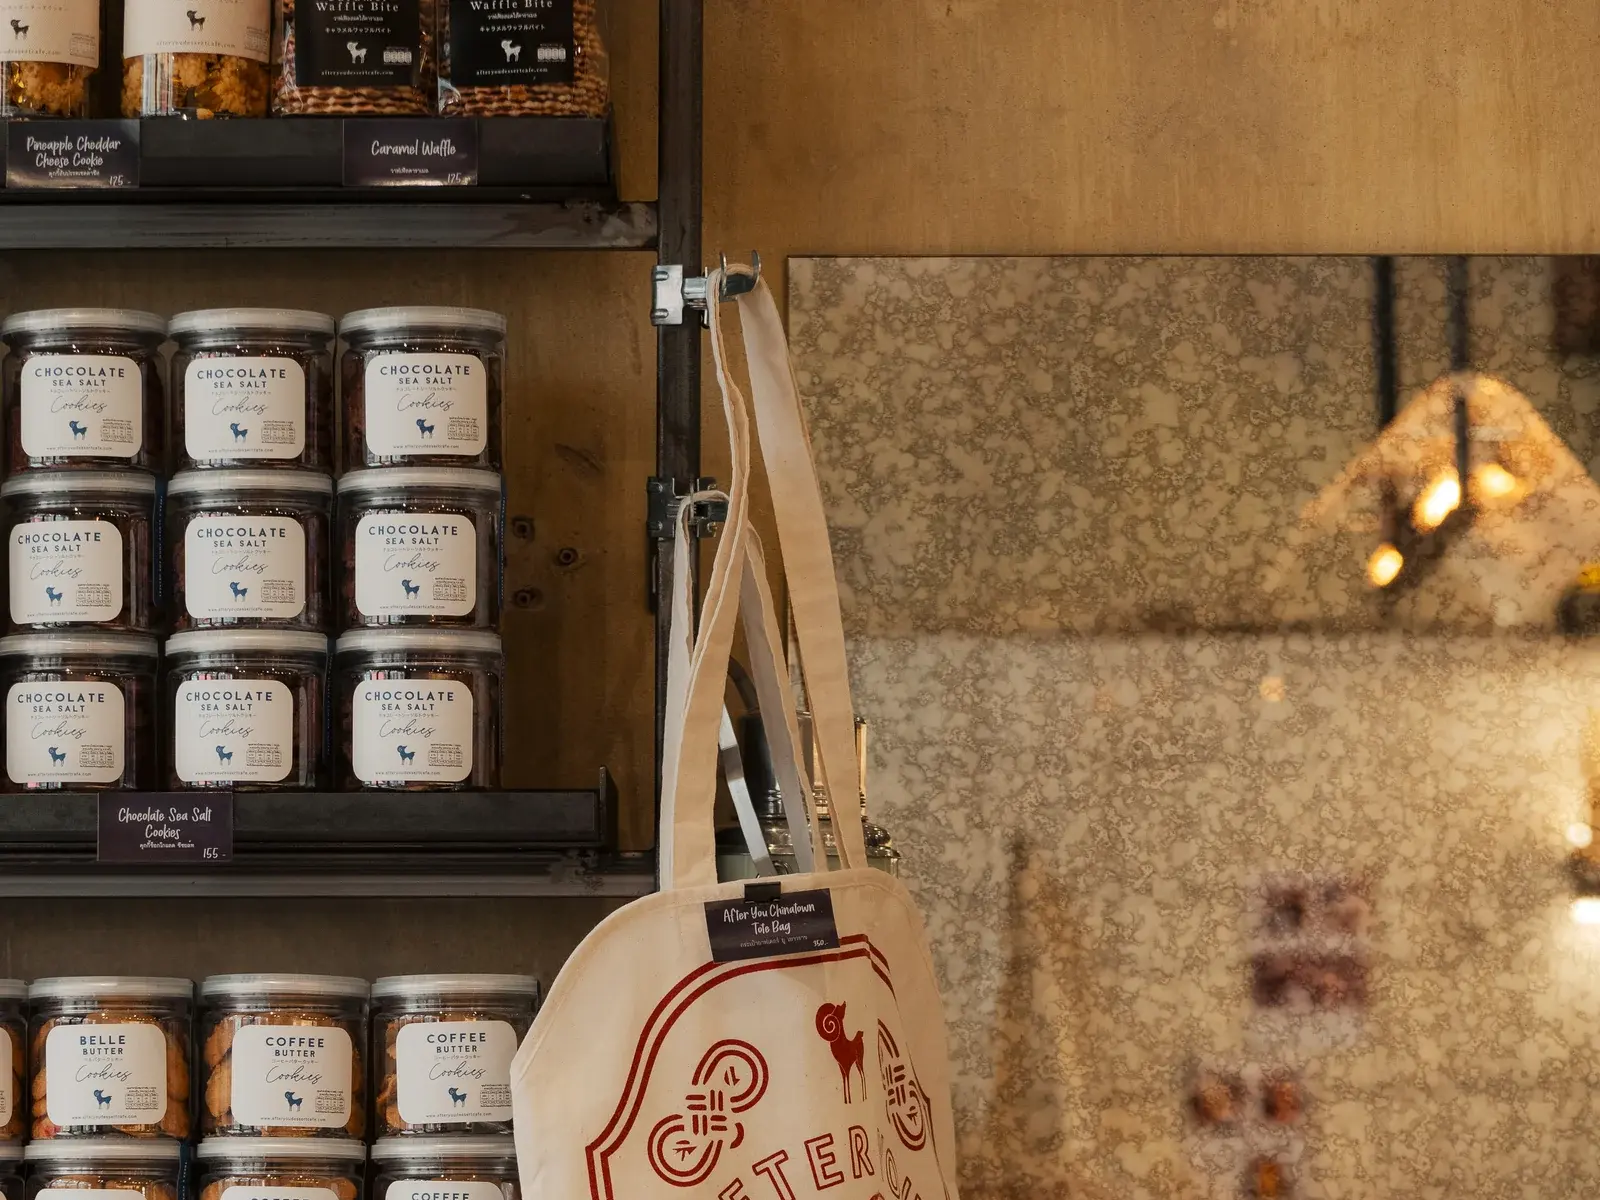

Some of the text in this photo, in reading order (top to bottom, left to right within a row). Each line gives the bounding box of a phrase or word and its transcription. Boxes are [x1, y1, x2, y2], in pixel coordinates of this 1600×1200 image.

[316, 2, 399, 12] Waffle Bite
[470, 0, 520, 11] Waffle
[26, 135, 121, 155] Pineapple Cheddar
[371, 139, 456, 157] Caramel Waffle
[35, 152, 103, 168] Cheese Cookie
[35, 366, 125, 378] CHOCOLATE
[197, 368, 287, 380] CHOCOLATE
[380, 364, 470, 376] CHOCOLATE
[52, 378, 106, 387] SEA SALT
[239, 381, 267, 389] SALT
[399, 377, 452, 385] SEA SALT
[51, 395, 108, 414] Cookies
[212, 397, 269, 416] Cookies
[397, 392, 455, 412] Cookies
[197, 527, 286, 538] CHOCOLATE
[368, 525, 458, 536] CHOCOLATE
[18, 532, 101, 544] CHOCOLATE
[412, 537, 439, 545] SALT
[54, 544, 81, 552] SALT
[212, 555, 269, 575] Cookies
[383, 553, 441, 573] Cookies
[30, 560, 83, 580] Cookies
[17, 693, 105, 703] CHOCOLATE
[186, 691, 273, 701] CHOCOLATE
[365, 691, 455, 702] CHOCOLATE
[33, 705, 85, 713] SEA SALT
[200, 703, 253, 711] SEA SALT
[381, 703, 435, 711] SEA SALT
[31, 720, 87, 740] Cookies
[199, 719, 255, 739] Cookies
[379, 719, 436, 738] Cookies
[118, 806, 212, 823] Chocolate Sea Salt
[145, 824, 181, 840] Cookies
[723, 902, 815, 923] After You Chinatown
[751, 920, 791, 935] Tote Bag
[79, 1035, 126, 1045] BELLE
[265, 1036, 324, 1048] COFFEE
[427, 1032, 486, 1044] COFFEE
[82, 1047, 124, 1055] BUTTER
[274, 1049, 315, 1058] BUTTER
[436, 1045, 478, 1054] BUTTER
[75, 1063, 132, 1082] Cookies
[266, 1064, 322, 1084] Cookies
[429, 1060, 486, 1081] Cookies
